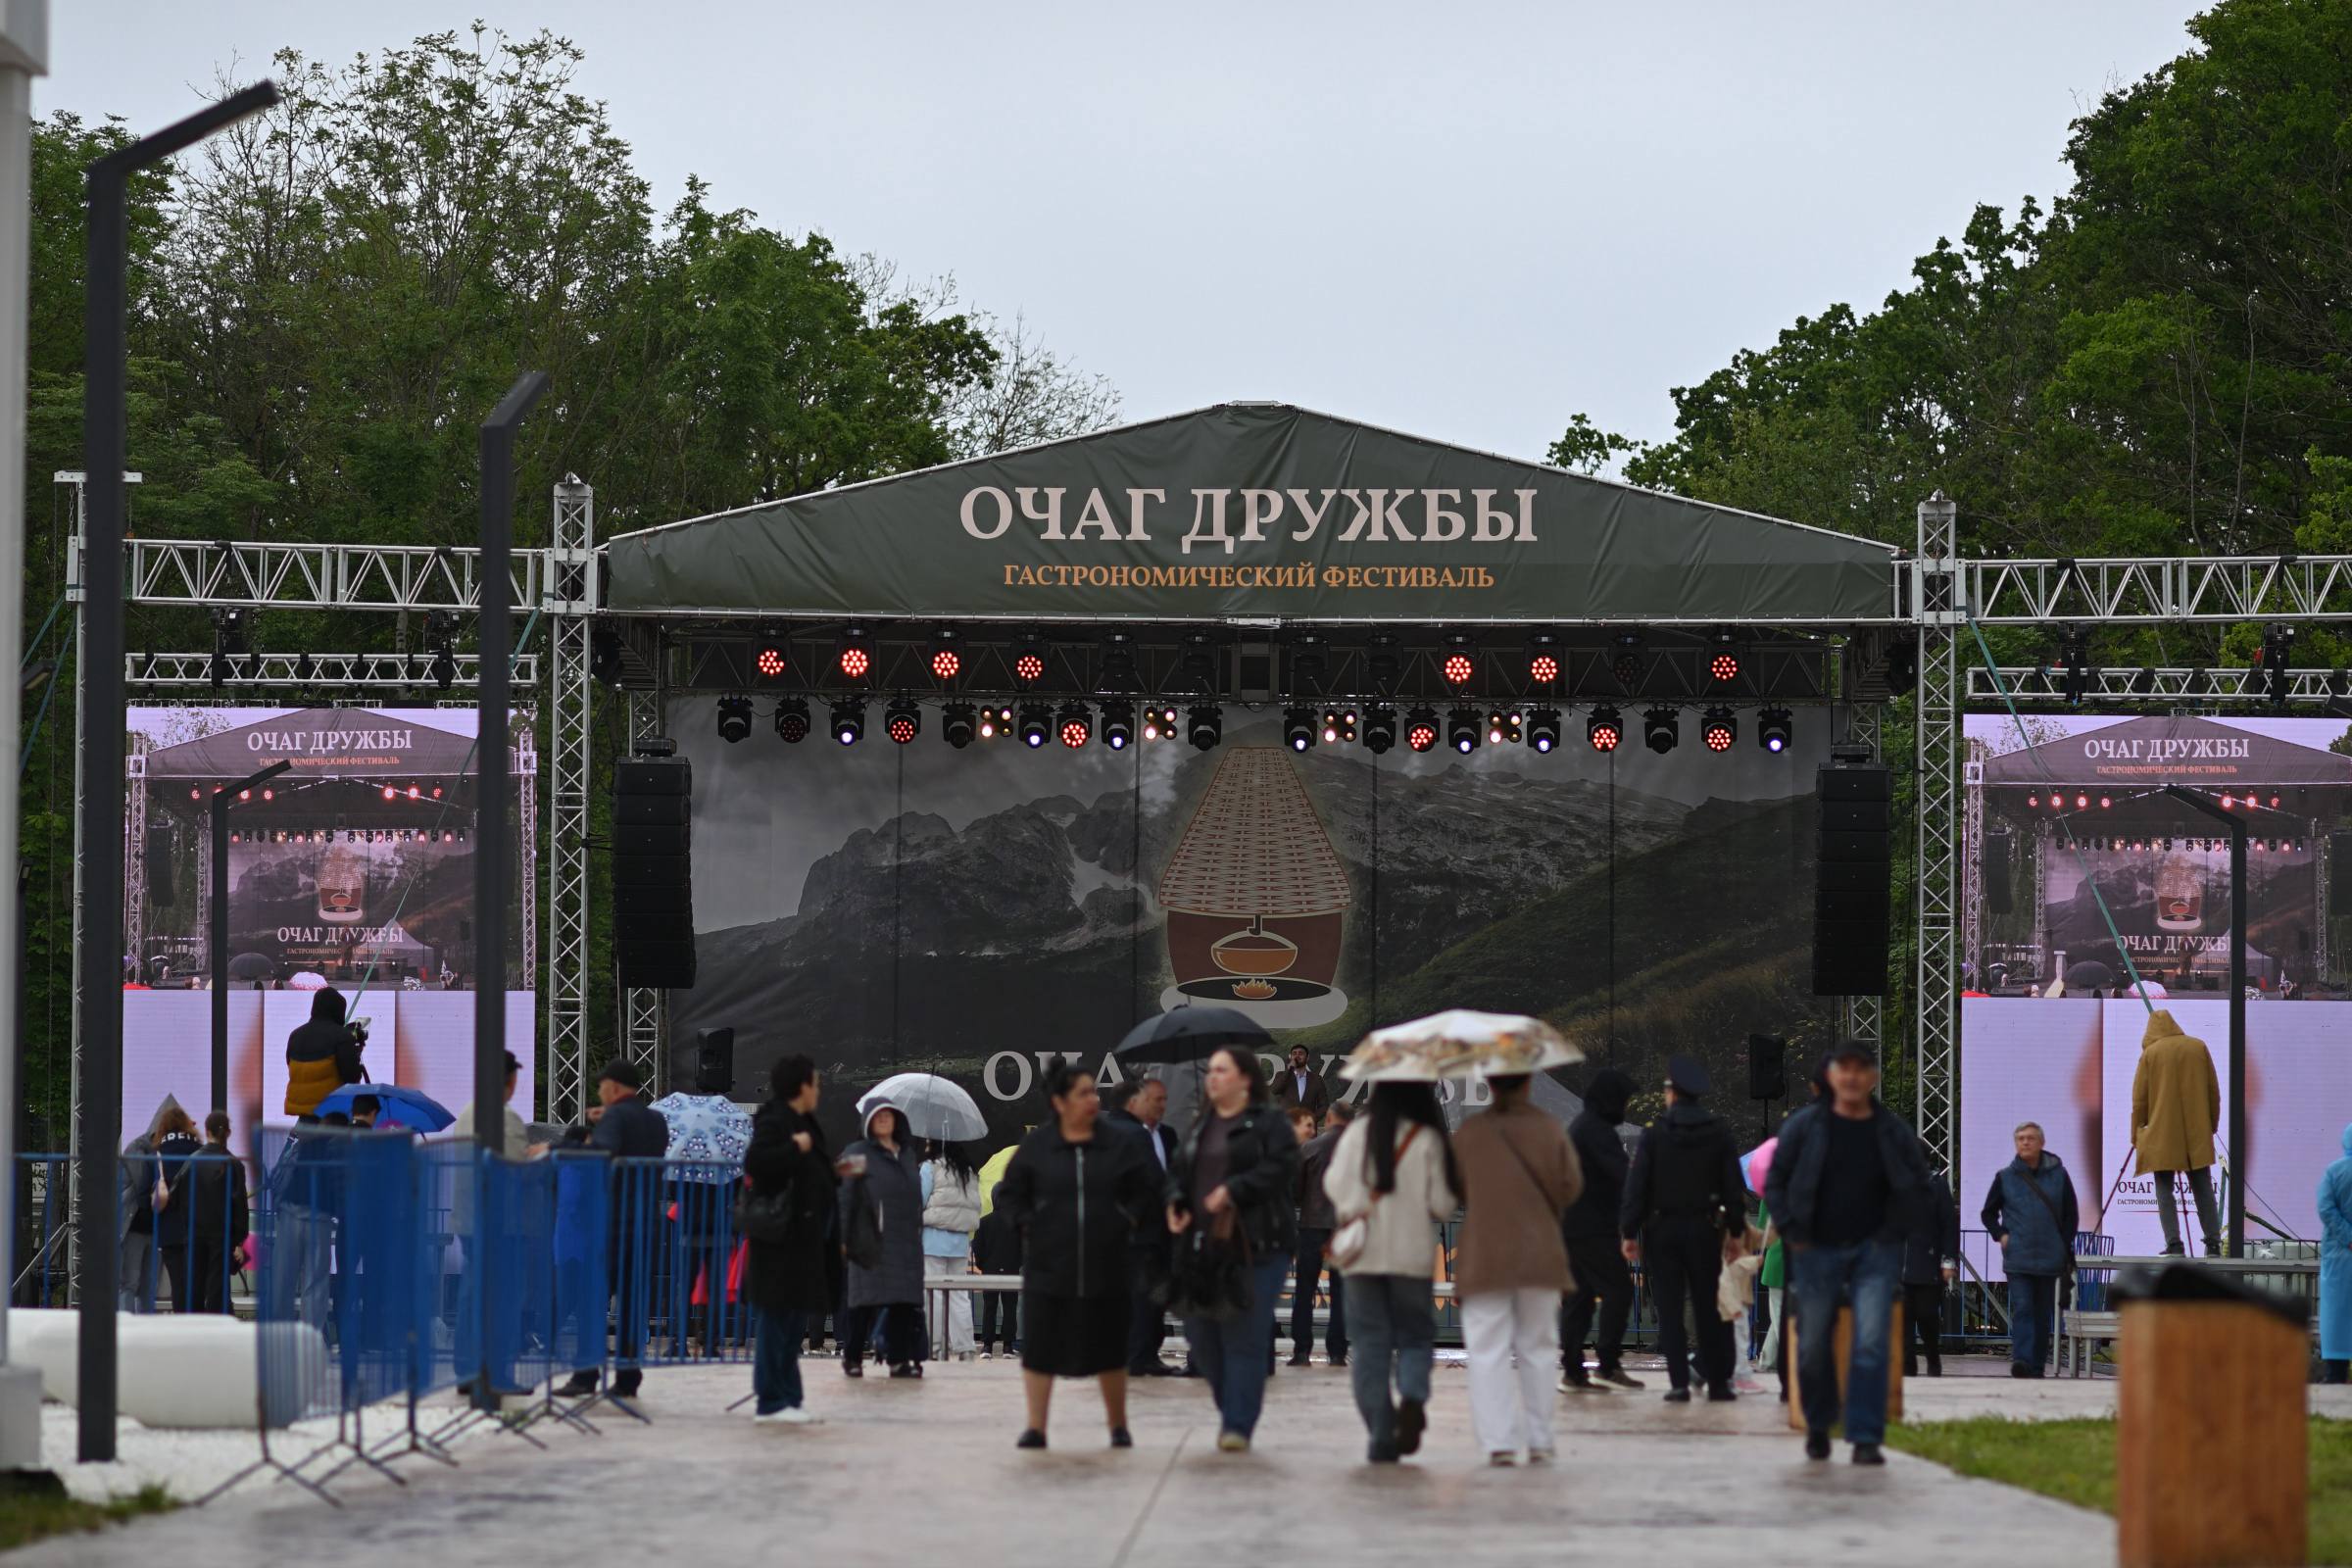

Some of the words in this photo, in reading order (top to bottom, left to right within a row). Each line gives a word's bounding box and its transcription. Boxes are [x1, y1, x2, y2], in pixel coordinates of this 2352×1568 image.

[960, 486, 1166, 541] ОЧАГ
[1182, 488, 1539, 554] ДРУЖБЫ
[1004, 562, 1316, 588] ГАСТРОНОМИЧЕСКИЙ
[1322, 564, 1495, 588] ФЕСТИВАЛЬ
[247, 731, 307, 751] ОЧАГ
[311, 730, 413, 755] ДРУЖБЫ
[2084, 739, 2144, 758] ОЧАГ
[2147, 738, 2250, 762] ДРУЖБЫ
[350, 756, 400, 765] ФЕСТИВАЛЬ
[2096, 764, 2186, 774] ГАСТРОНОМИЧЕСКИЙ
[2187, 764, 2237, 774] ФЕСТИВАЛЬ
[277, 926, 323, 942] ОЧАГ
[2118, 1181, 2154, 1194] ОЧАГ
